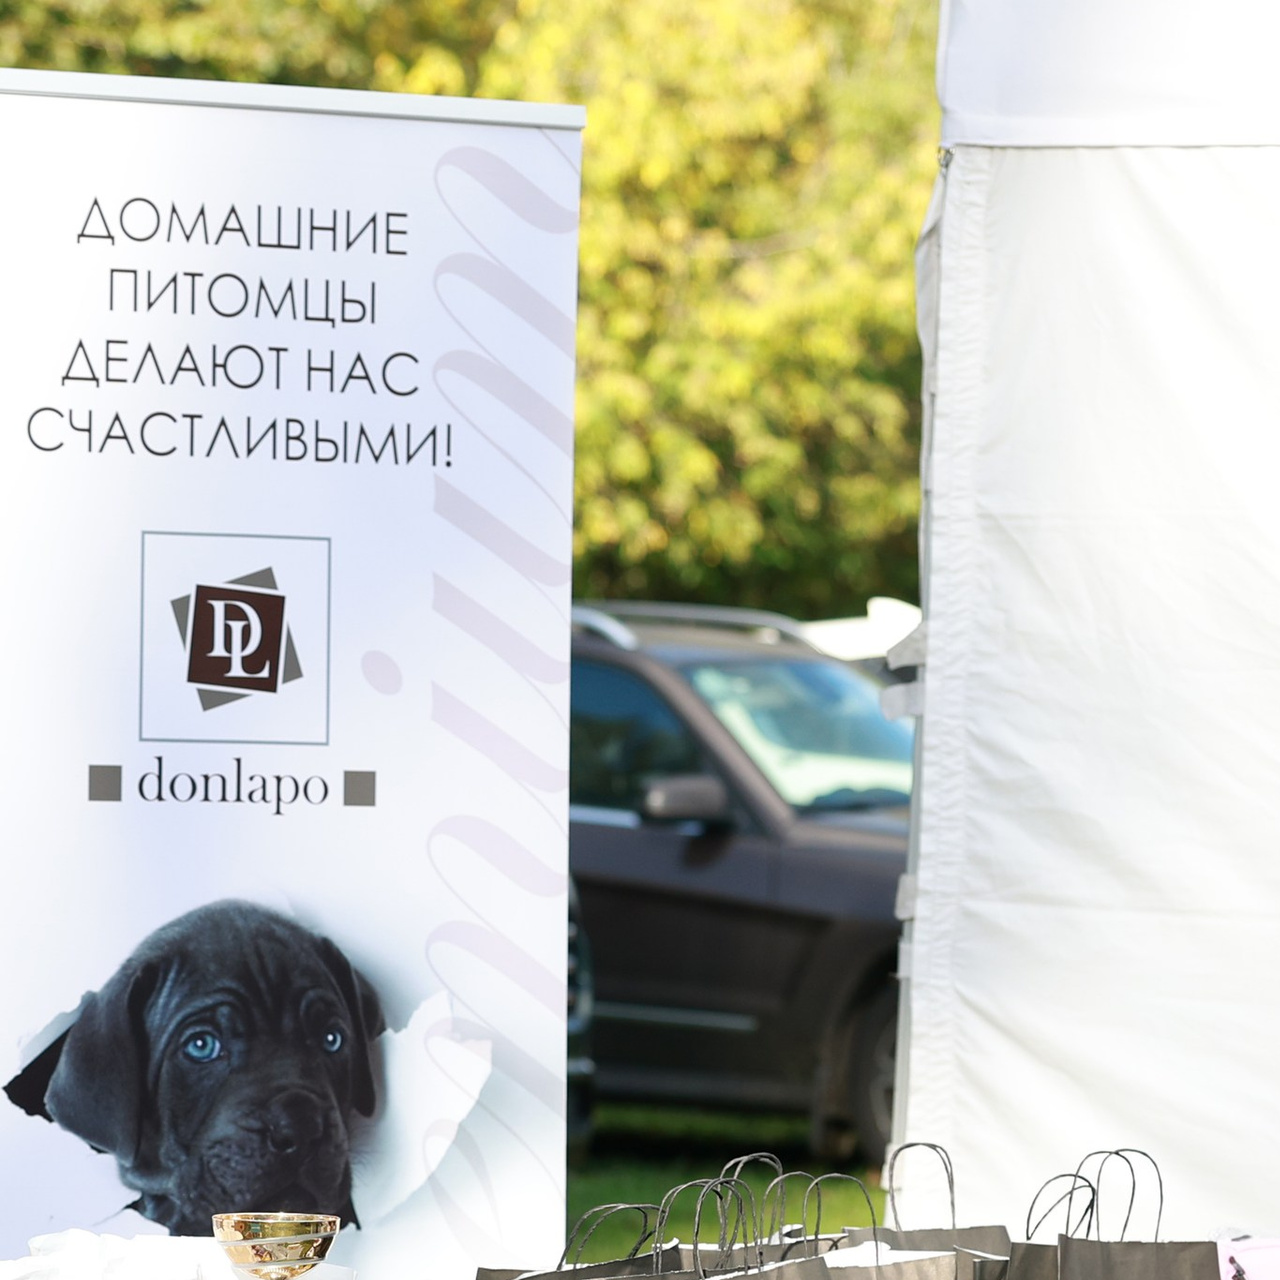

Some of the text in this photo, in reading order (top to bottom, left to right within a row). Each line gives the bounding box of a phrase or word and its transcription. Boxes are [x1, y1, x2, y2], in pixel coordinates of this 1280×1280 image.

[77, 197, 409, 256] ДОМАШНИЕ
[109, 268, 377, 328] ПИТОМЦЫ
[62, 339, 420, 396] ДЕЛАЮТ НАС
[27, 406, 454, 468] СЧАСТЛИВЫМИ!
[138, 756, 329, 816] donlapo
